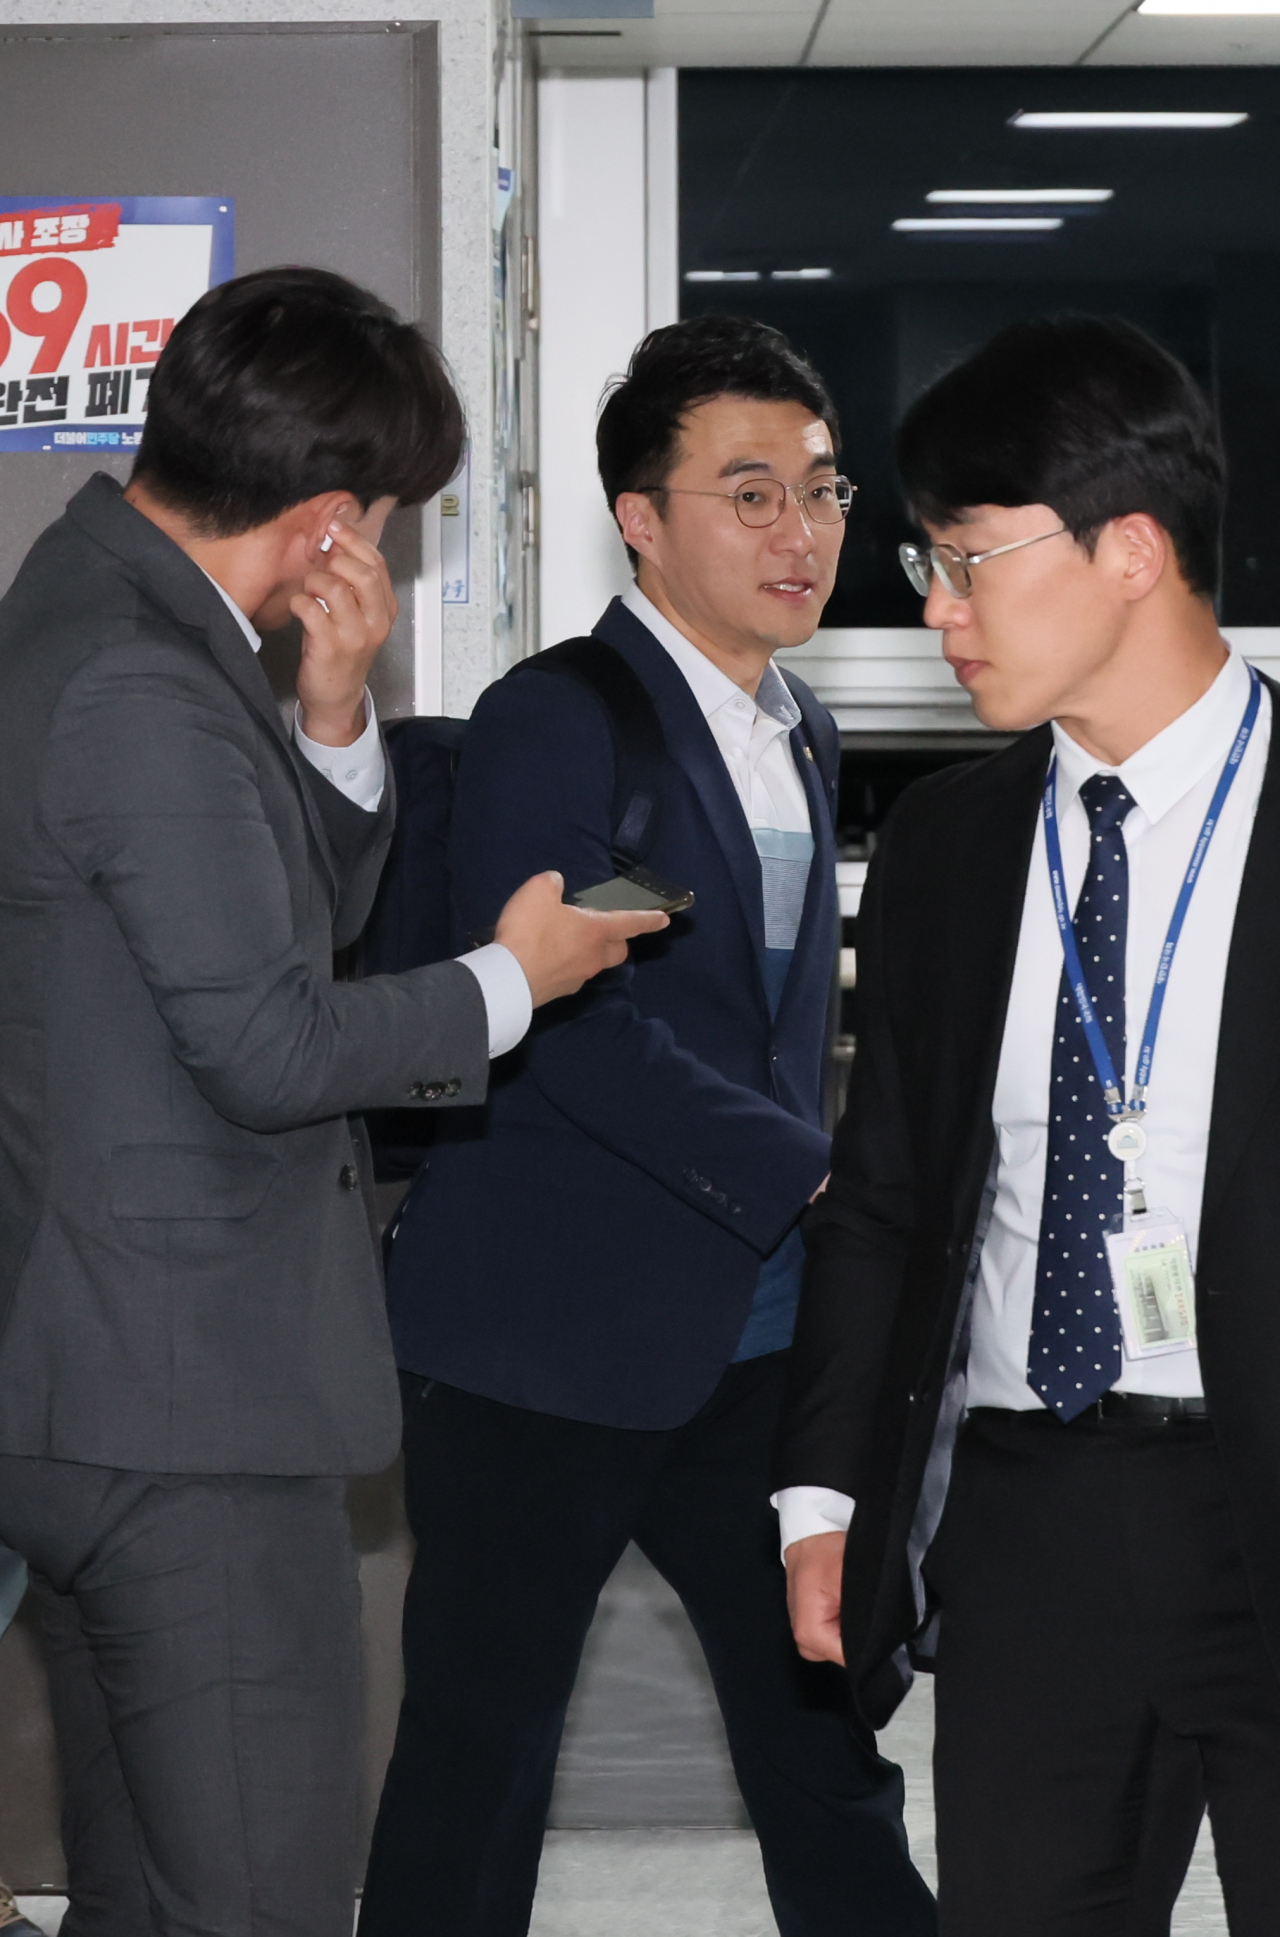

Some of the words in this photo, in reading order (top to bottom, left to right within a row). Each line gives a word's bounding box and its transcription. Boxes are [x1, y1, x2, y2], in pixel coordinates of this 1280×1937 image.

[31, 214, 90, 247] 조장
[0, 257, 88, 375] 9
[54, 431, 120, 445] 더불어민주당
